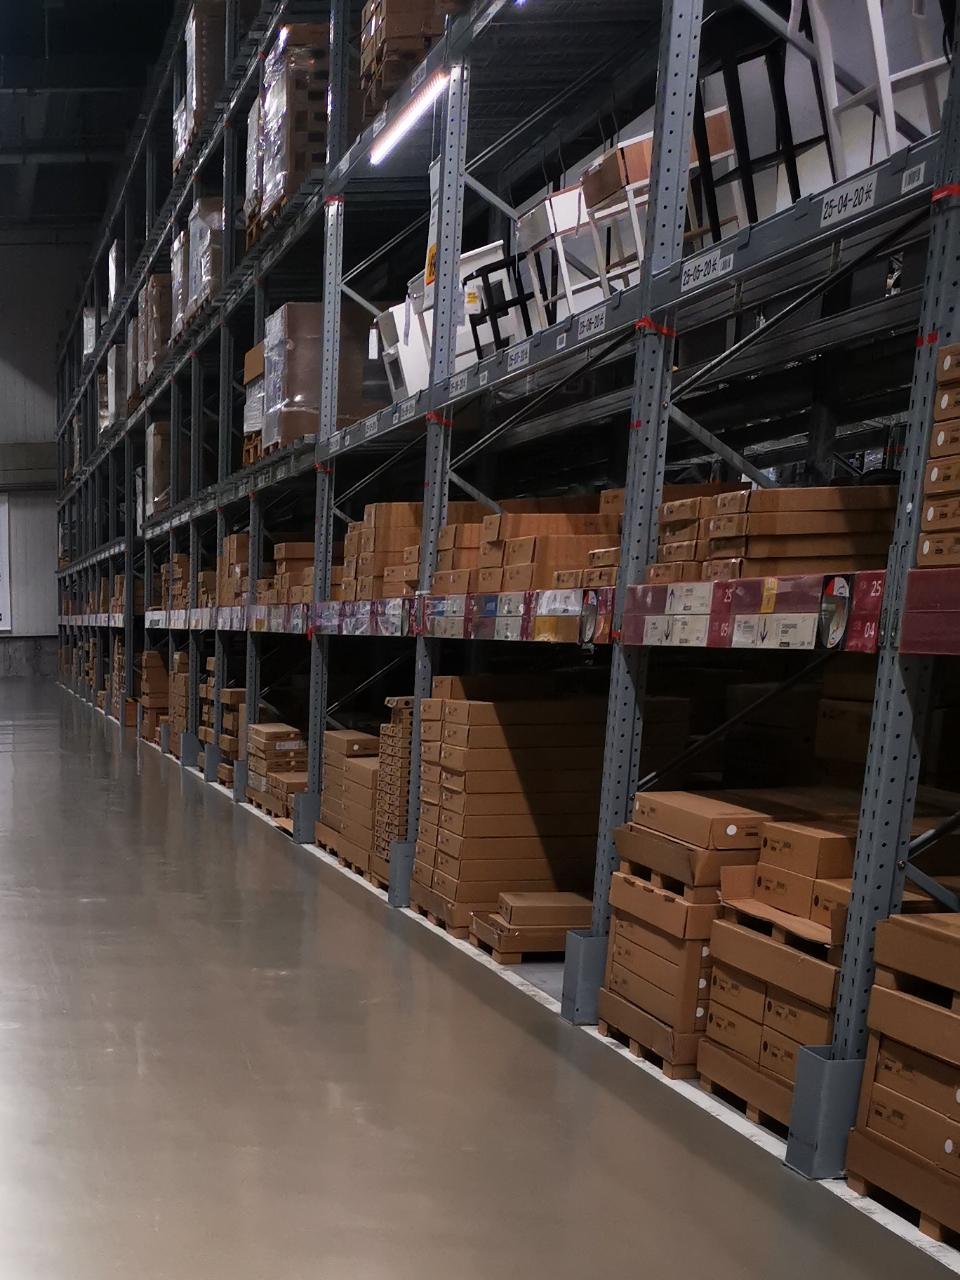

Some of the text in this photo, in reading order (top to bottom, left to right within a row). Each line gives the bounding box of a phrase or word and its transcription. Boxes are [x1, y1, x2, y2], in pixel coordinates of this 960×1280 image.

[822, 182, 873, 221] 25-04-20长
[723, 589, 733, 603] 25
[870, 580, 882, 597] 25
[720, 622, 729, 637] 05
[864, 622, 876, 638] 04
